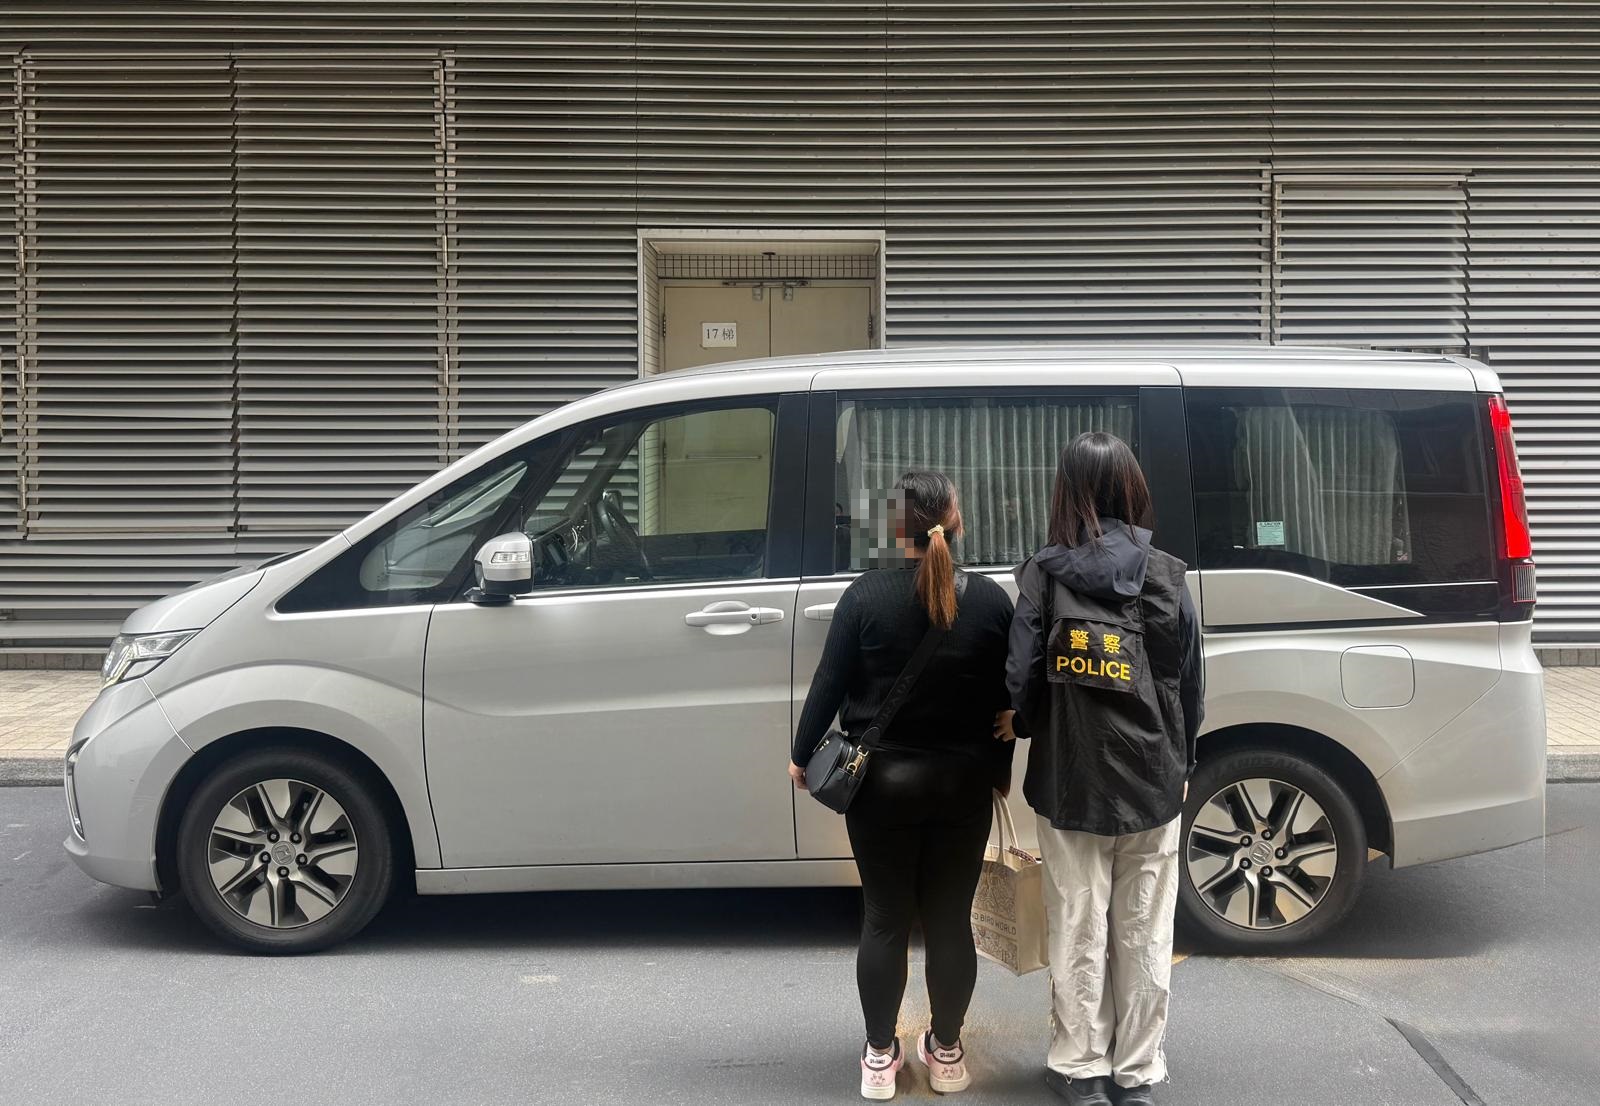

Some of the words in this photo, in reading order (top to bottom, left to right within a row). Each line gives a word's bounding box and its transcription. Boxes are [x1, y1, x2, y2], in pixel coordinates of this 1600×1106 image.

[705, 328, 719, 340] 17
[1070, 629, 1120, 654] 警察
[1056, 655, 1131, 681] POLICE
[995, 919, 1017, 935] WORLD
